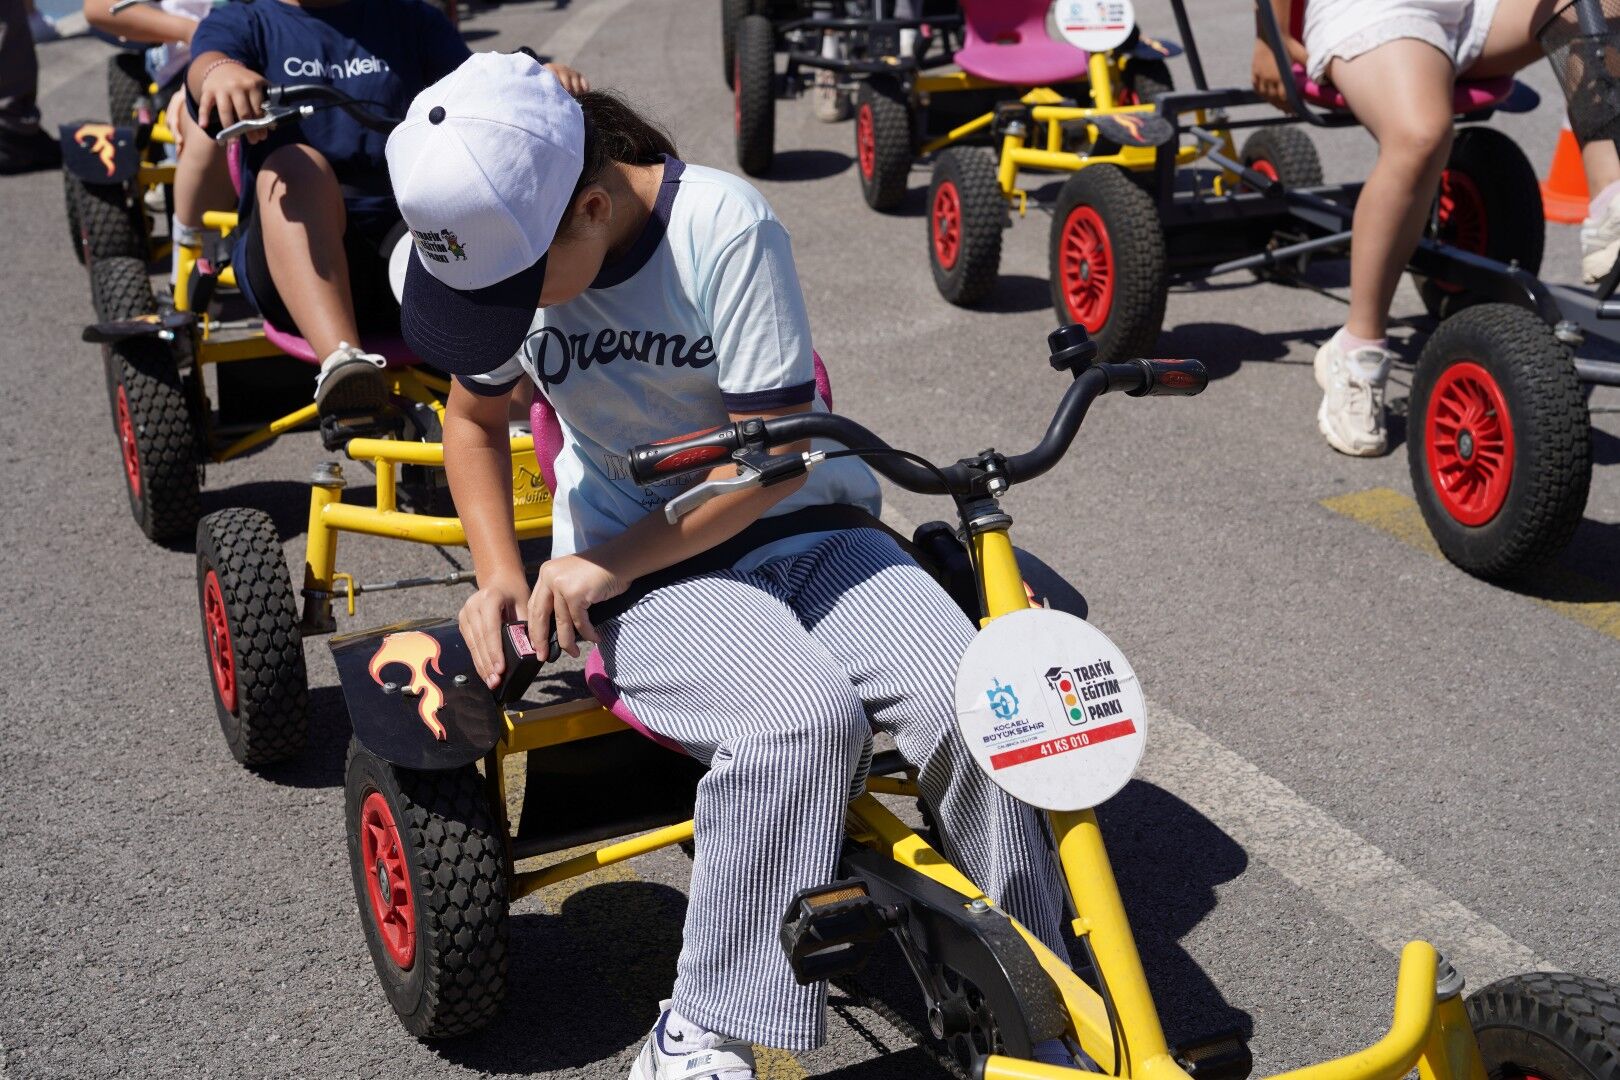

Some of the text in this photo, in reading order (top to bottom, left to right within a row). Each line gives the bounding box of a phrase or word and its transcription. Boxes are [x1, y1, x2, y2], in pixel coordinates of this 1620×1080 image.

[523, 326, 717, 394] Dreame
[1073, 658, 1115, 683] TRAFİK
[1080, 677, 1121, 702] EĞİTİM
[1087, 698, 1124, 721] PARKI
[1040, 742, 1053, 756] 41
[1054, 738, 1069, 752] KS
[1070, 733, 1090, 747] 010
[686, 1053, 714, 1071] NIKE
